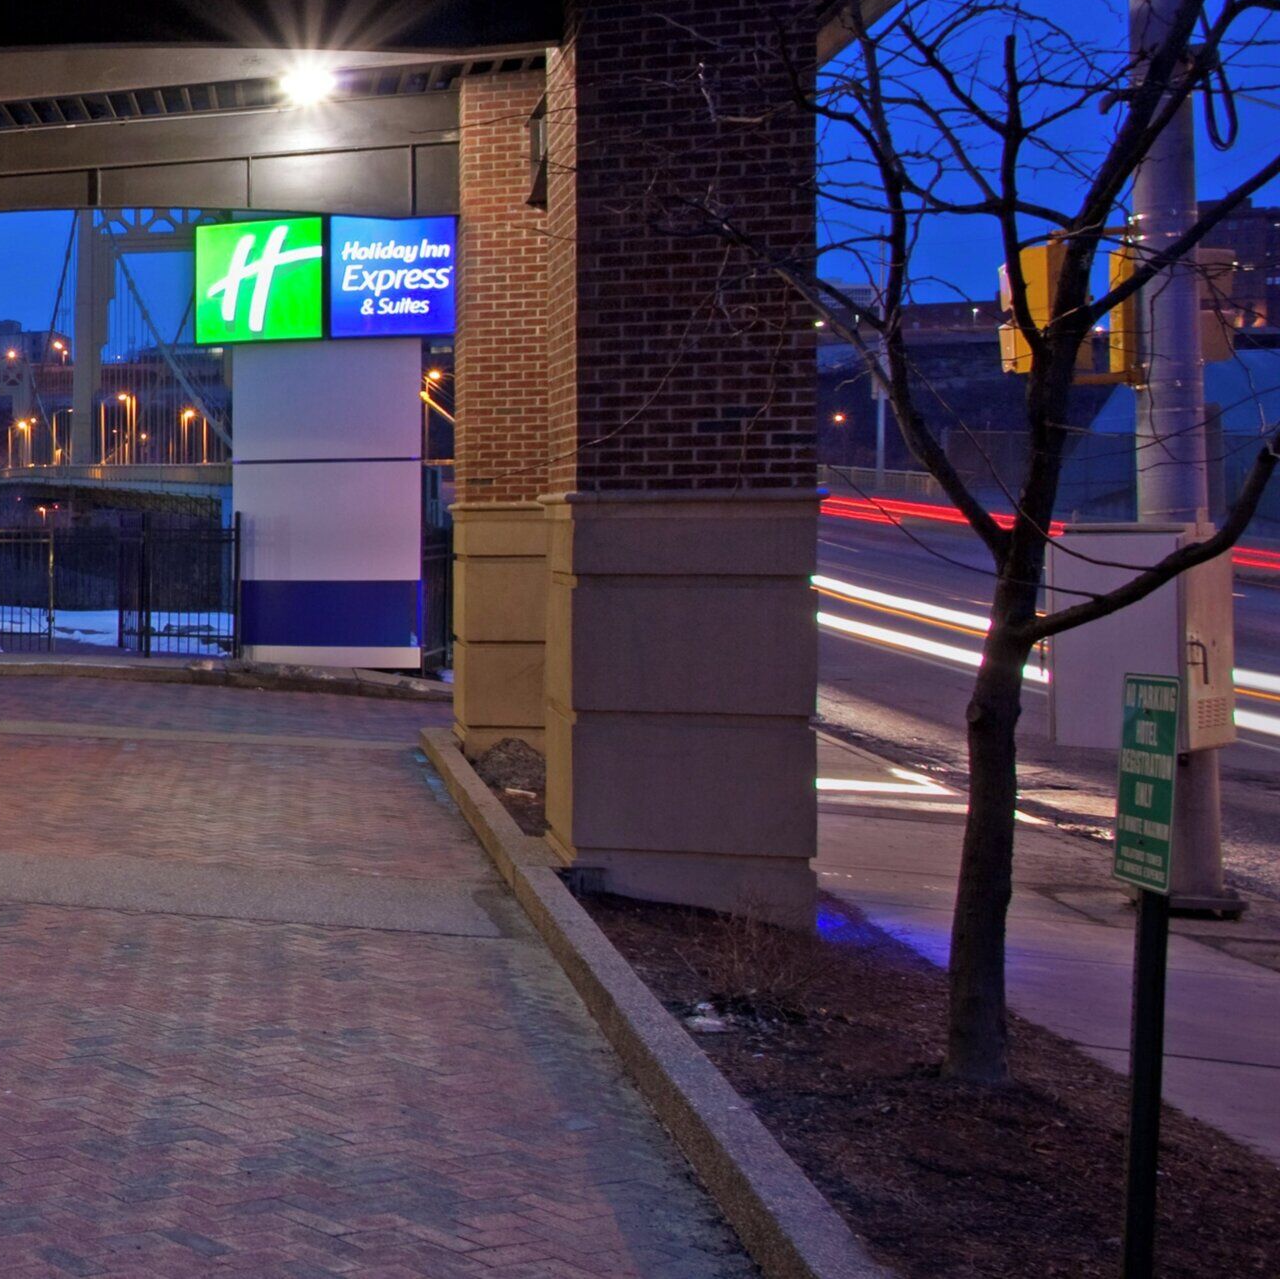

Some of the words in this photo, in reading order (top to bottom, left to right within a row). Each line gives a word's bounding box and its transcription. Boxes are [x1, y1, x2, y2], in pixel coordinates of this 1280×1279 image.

[341, 240, 419, 263] Holiday
[420, 238, 451, 258] Inn
[342, 264, 450, 297] Express
[360, 298, 375, 315] &
[376, 297, 431, 315] Suites
[1125, 683, 1137, 708] NO
[1137, 685, 1177, 712] PARKING
[1135, 720, 1158, 747] HOTEL
[1121, 748, 1173, 780] REGISTRATION
[1135, 781, 1154, 808] ONLY
